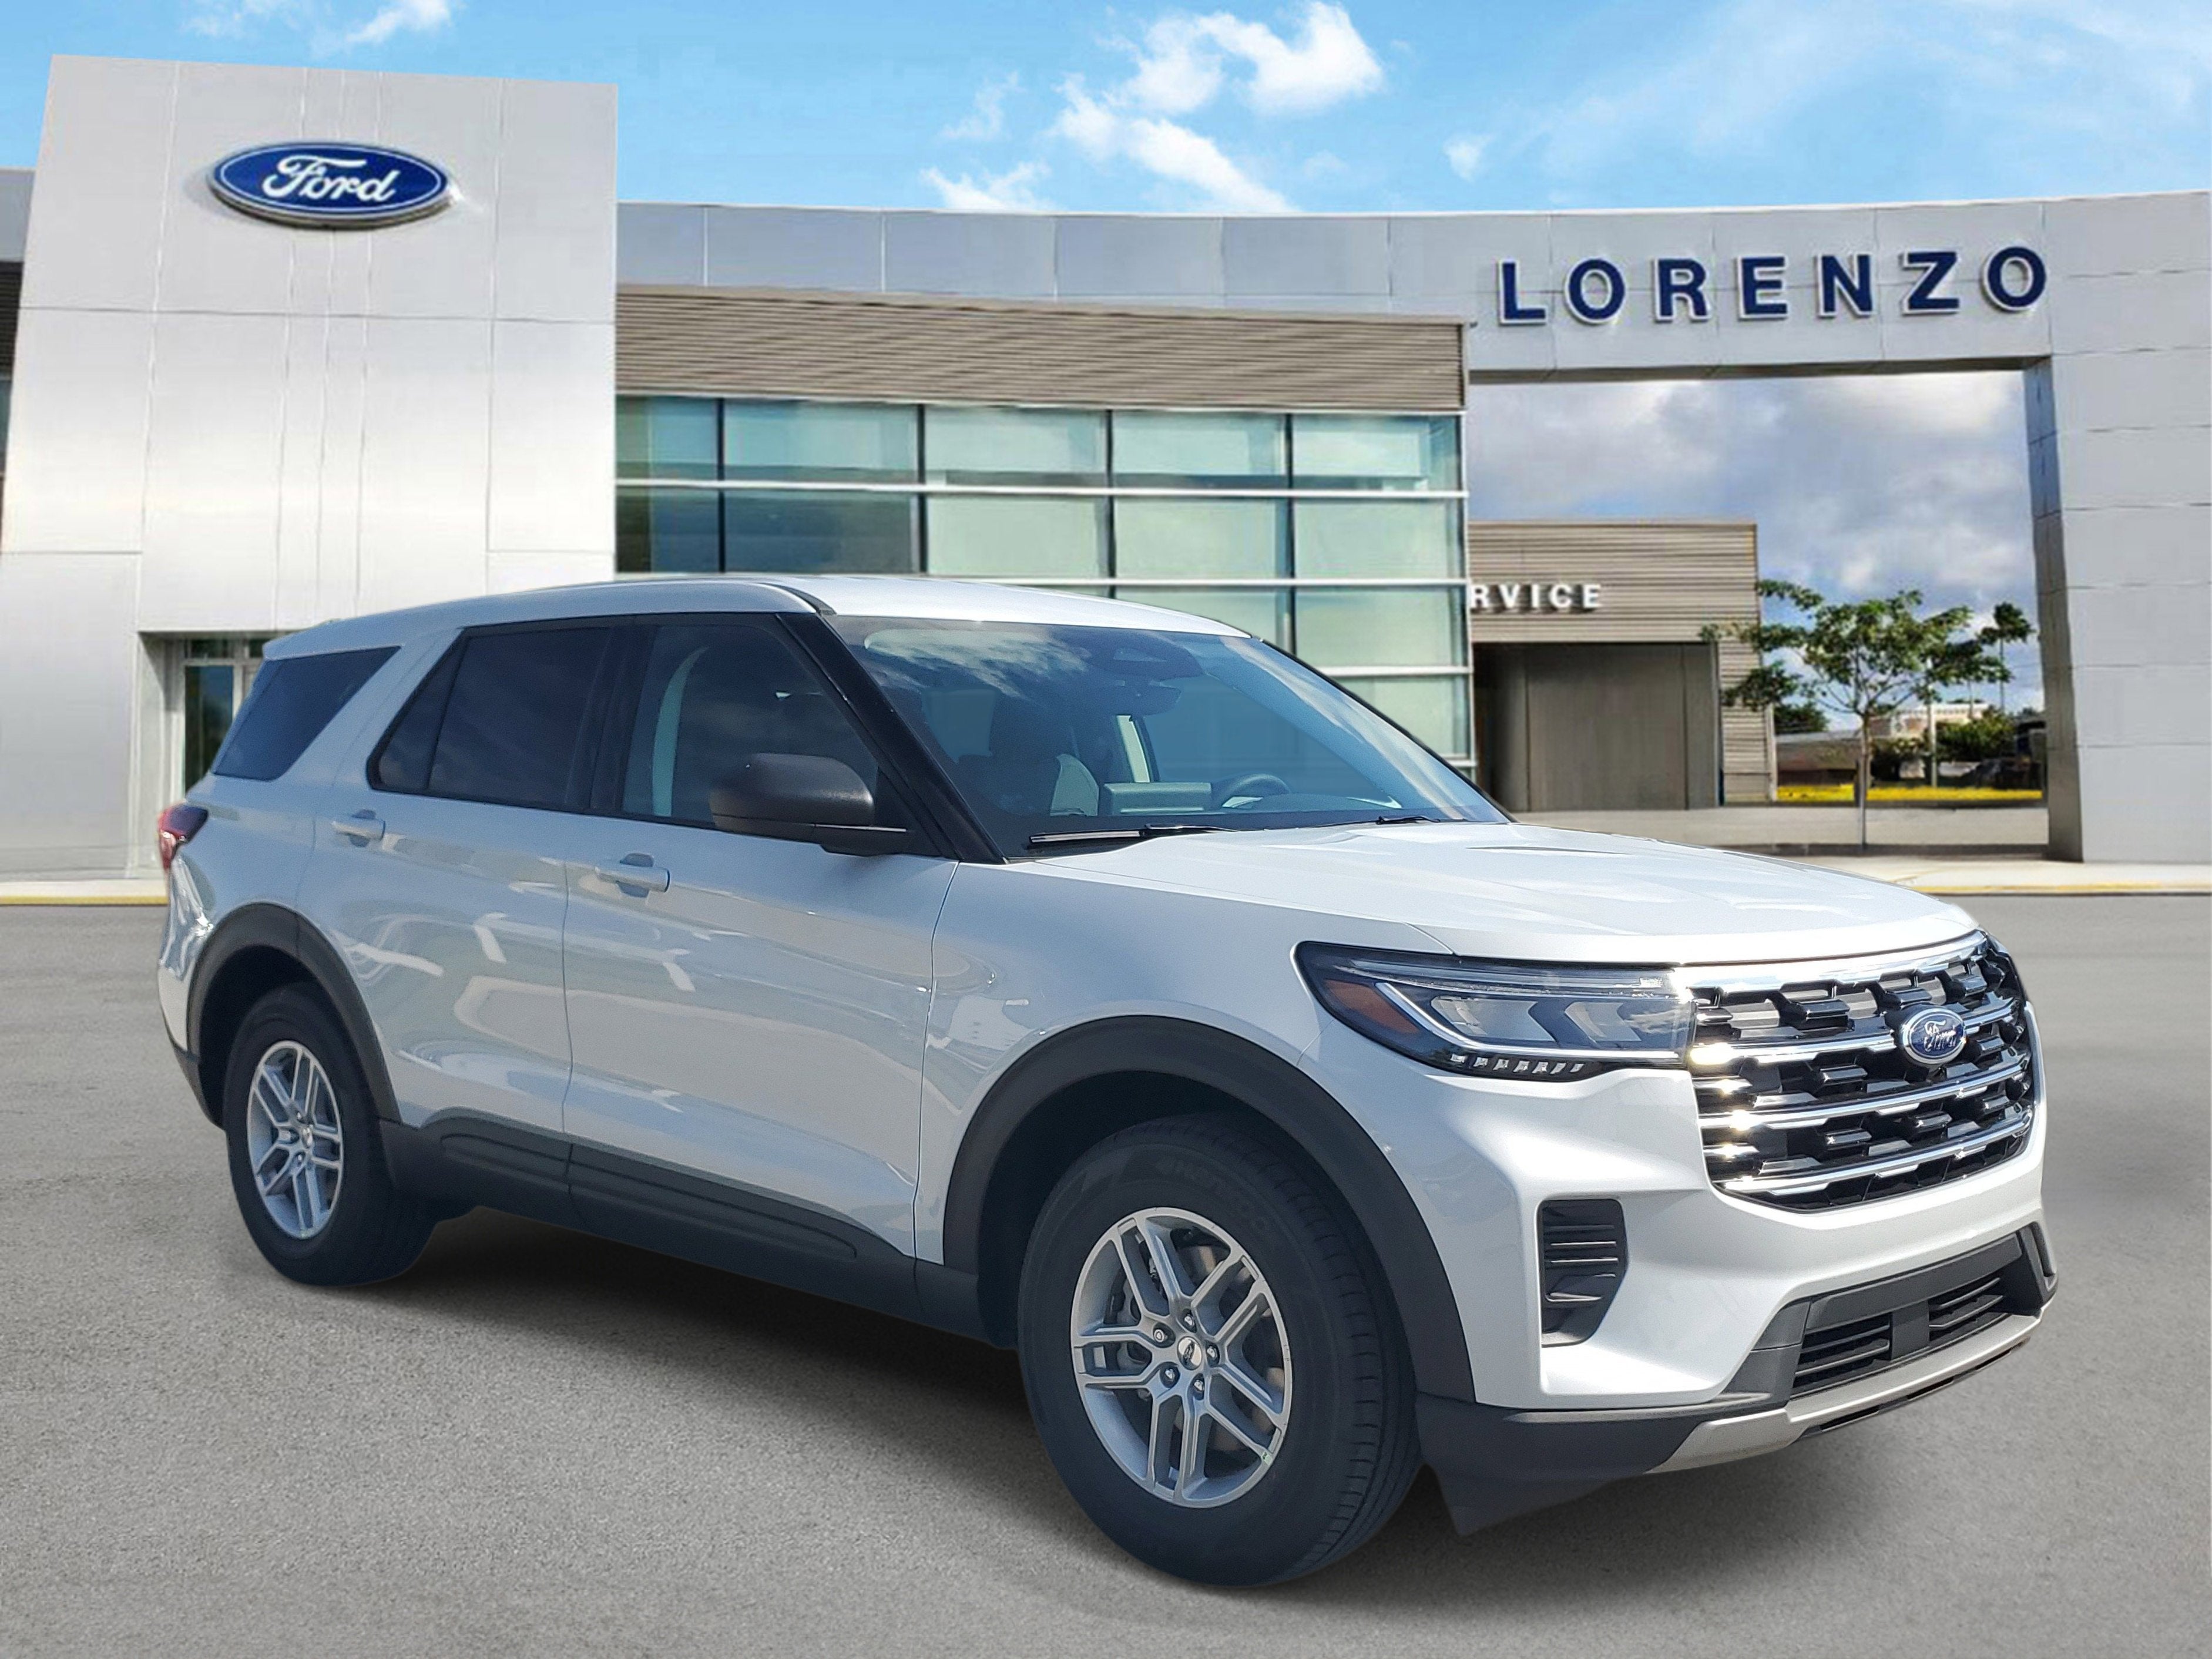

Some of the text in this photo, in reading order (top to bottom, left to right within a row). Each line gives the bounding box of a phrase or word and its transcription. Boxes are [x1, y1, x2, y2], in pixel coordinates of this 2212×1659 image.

[261, 155, 400, 202] Ford
[1498, 246, 2047, 324] LORENZO
[1924, 1020, 1956, 1052] Ford
